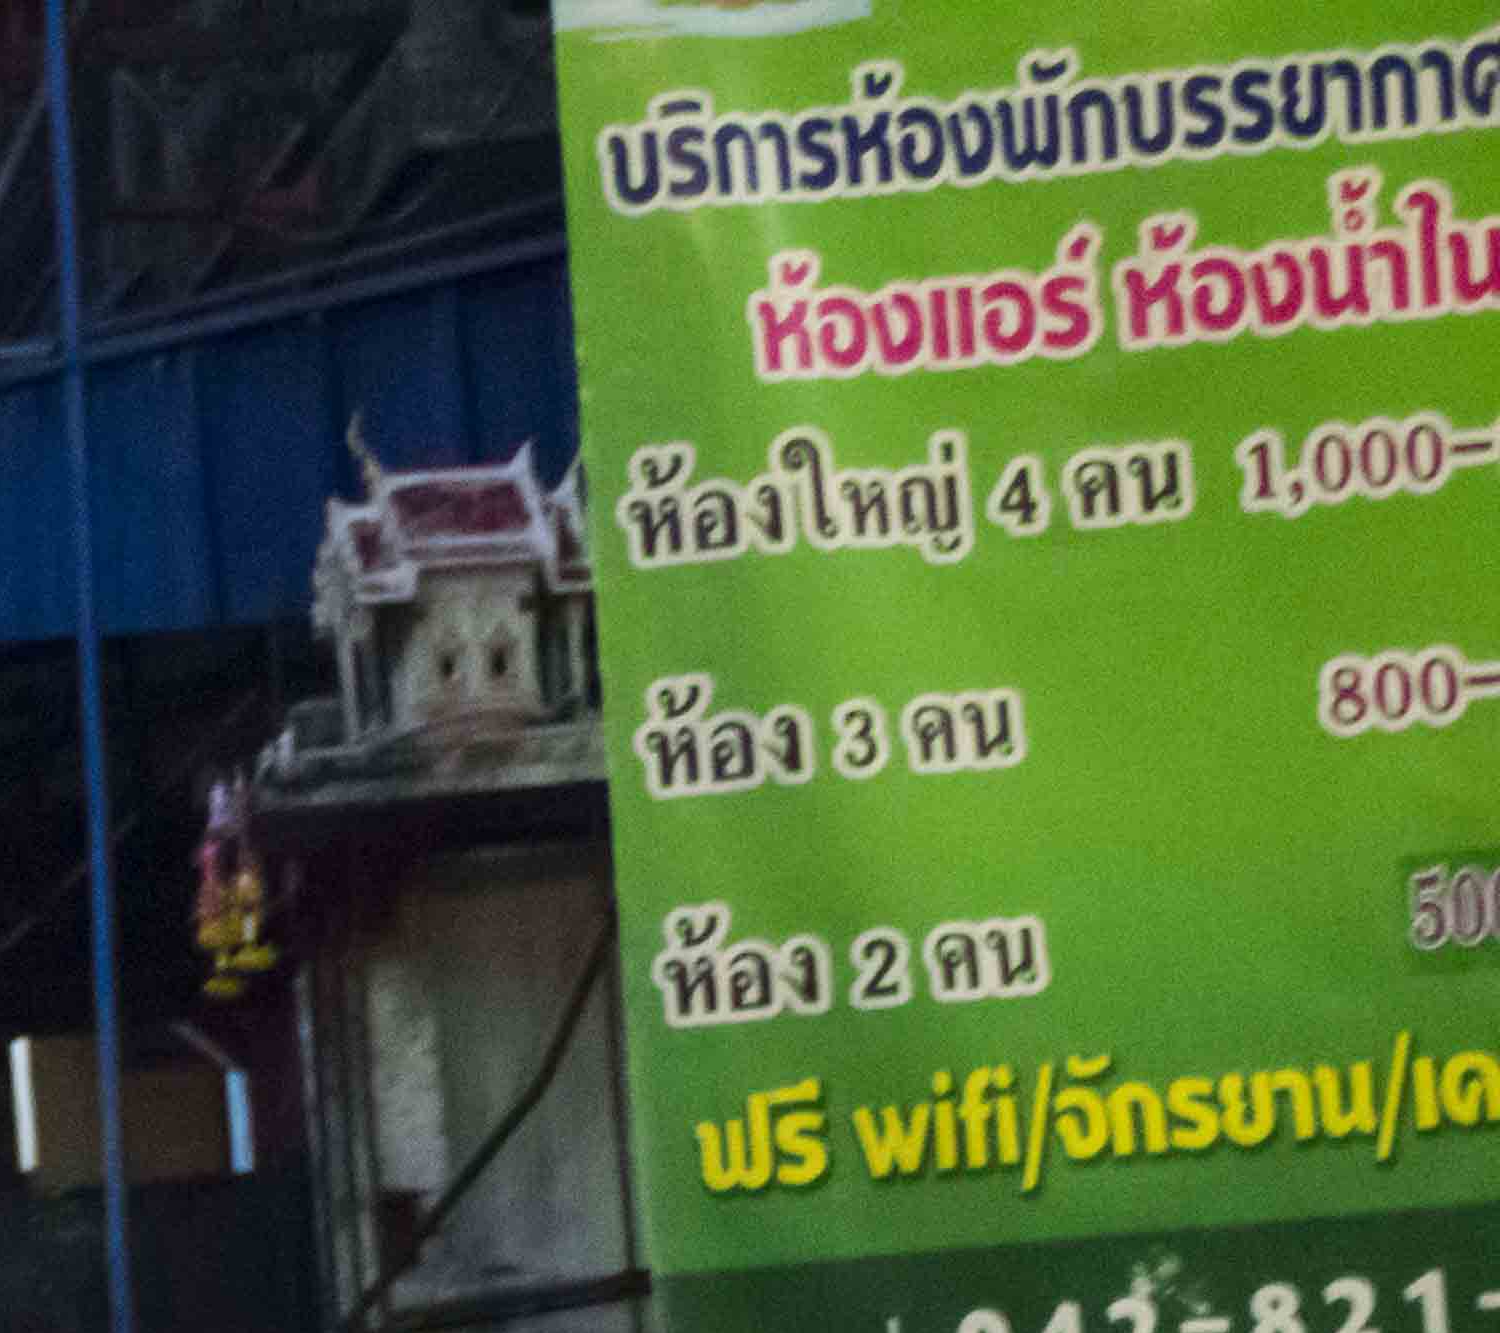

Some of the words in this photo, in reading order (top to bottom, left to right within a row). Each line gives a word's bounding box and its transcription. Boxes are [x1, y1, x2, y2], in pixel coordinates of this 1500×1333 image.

[757, 234, 1094, 374] ห้องแอร์
[1126, 178, 1500, 338] ห้องน้ำใน
[627, 436, 965, 560] ห้องใหญ่
[998, 465, 1040, 527] 4
[1074, 452, 1182, 515] คน
[645, 684, 805, 790] ห้อง
[843, 708, 879, 768] 3
[910, 699, 1015, 762] คน
[662, 914, 820, 1018] ห้อง
[861, 937, 900, 999] 2
[934, 927, 1039, 990] คน
[1412, 867, 1500, 948] 50
[695, 1078, 828, 1193] ฟรี
